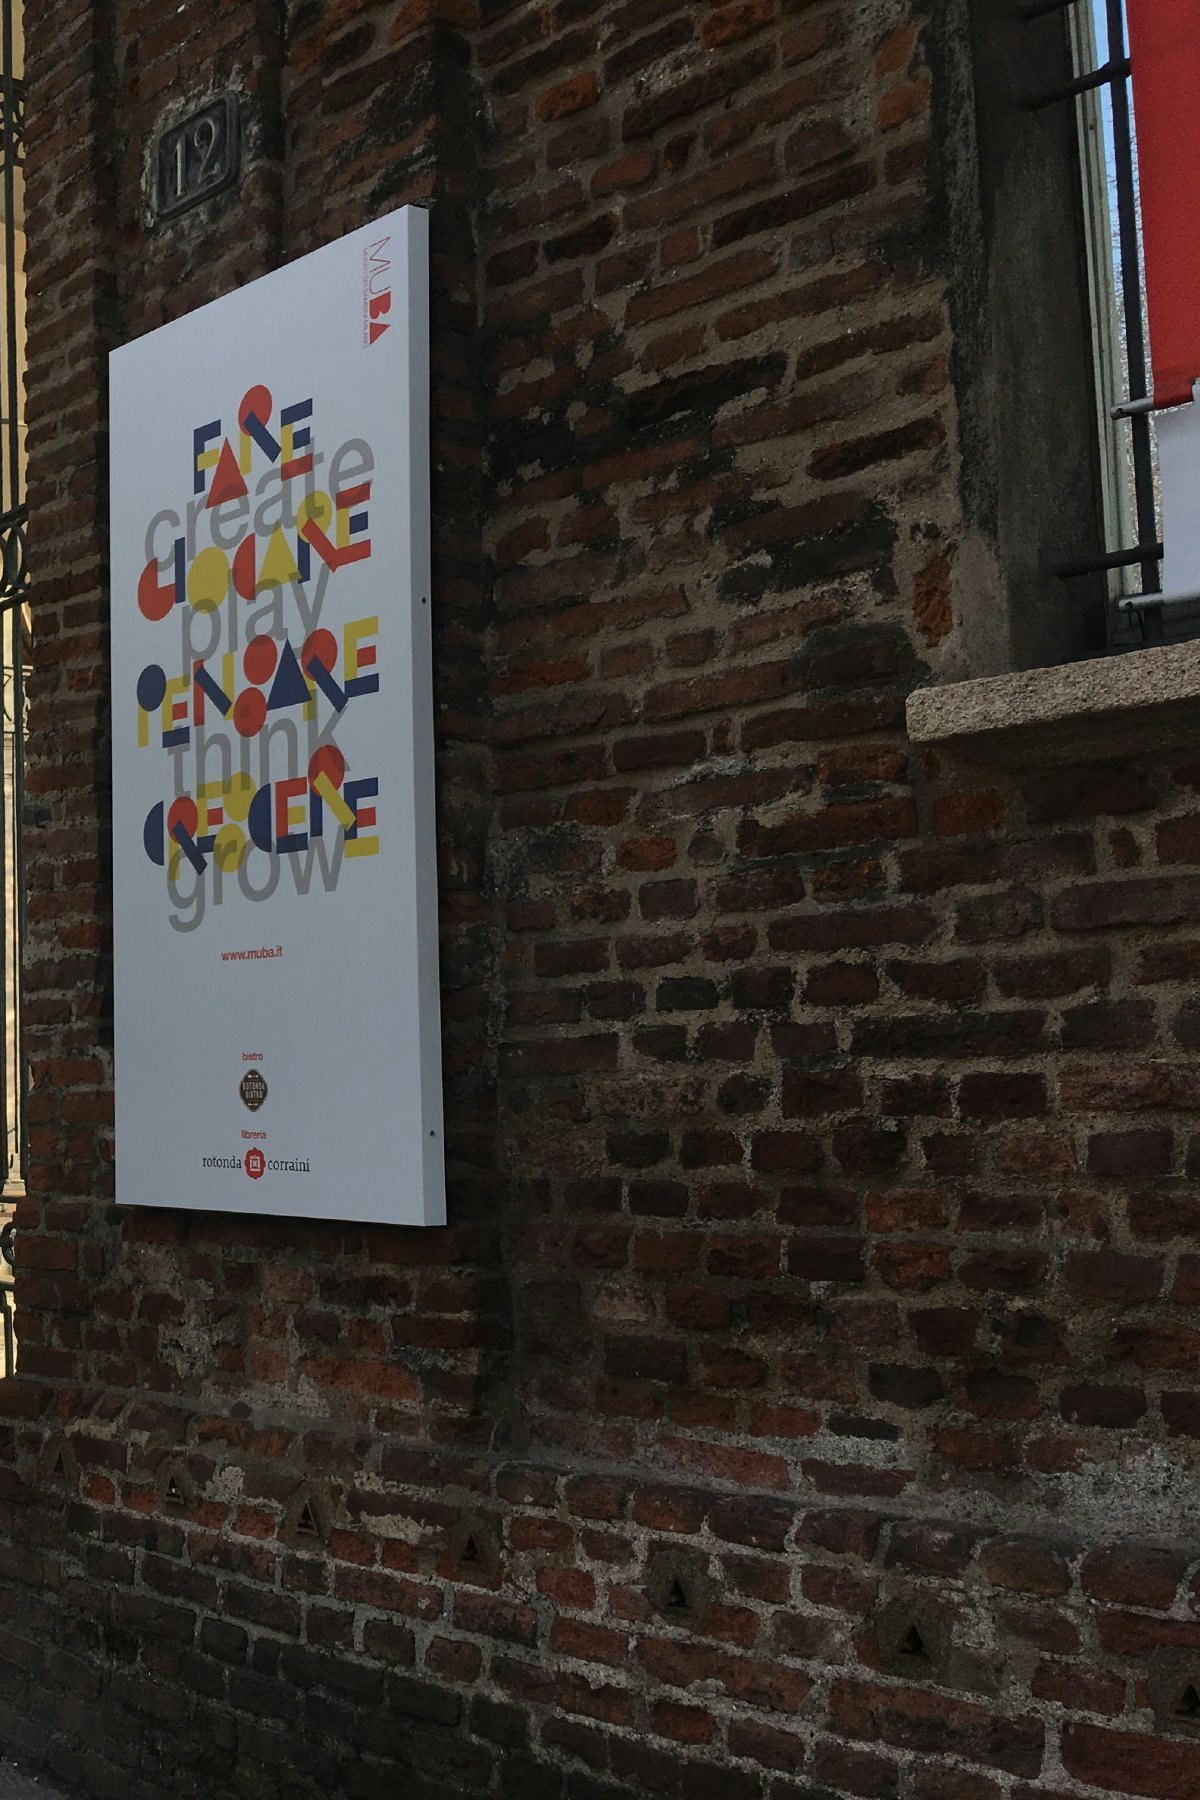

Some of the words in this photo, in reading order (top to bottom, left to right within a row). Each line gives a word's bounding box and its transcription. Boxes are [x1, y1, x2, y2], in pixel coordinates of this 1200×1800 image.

[175, 117, 221, 197] 12
[369, 235, 391, 346] MUBA
[193, 384, 313, 509] FARE
[144, 436, 374, 573] create
[181, 563, 329, 686] play
[136, 616, 379, 748] PENSARE
[167, 689, 351, 799] think
[166, 823, 347, 933] grow
[221, 944, 283, 961] www.muba.it
[242, 1051, 263, 1061] bistro
[242, 1081, 265, 1091] ROTONDA
[202, 1155, 242, 1168] rotonda
[267, 1157, 310, 1172] corraini
[241, 1129, 267, 1139] libreria
